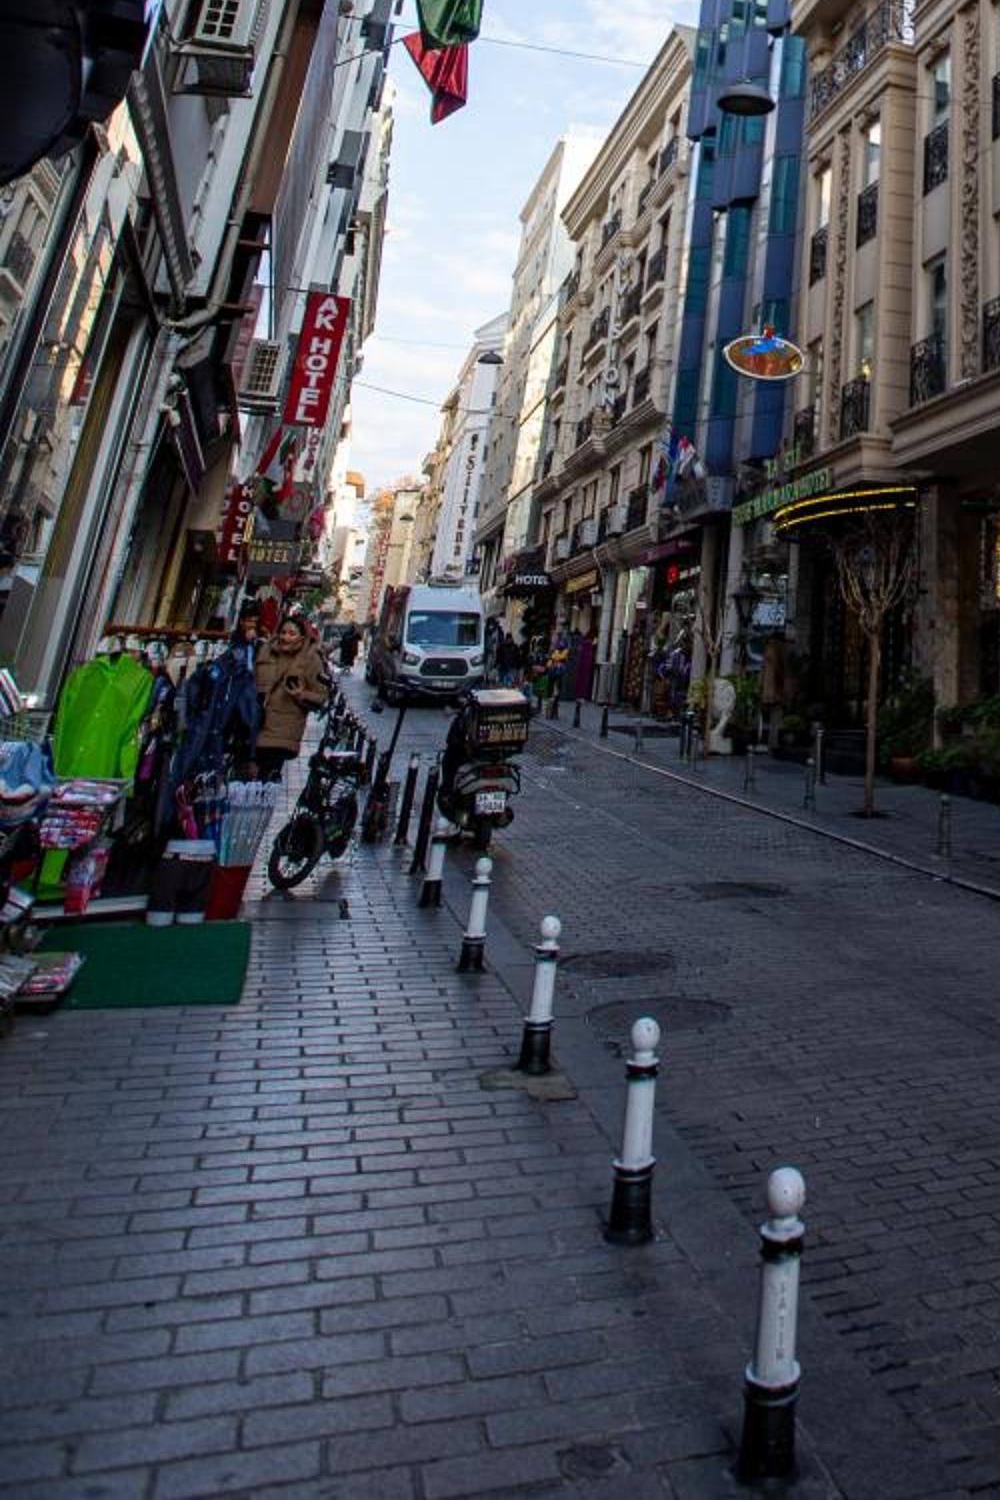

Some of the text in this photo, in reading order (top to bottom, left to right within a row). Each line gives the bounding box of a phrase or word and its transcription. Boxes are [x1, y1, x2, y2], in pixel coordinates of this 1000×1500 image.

[295, 297, 339, 423] AK HOTEL
[227, 484, 254, 562] HOTEL
[515, 573, 550, 586] HOTEL
